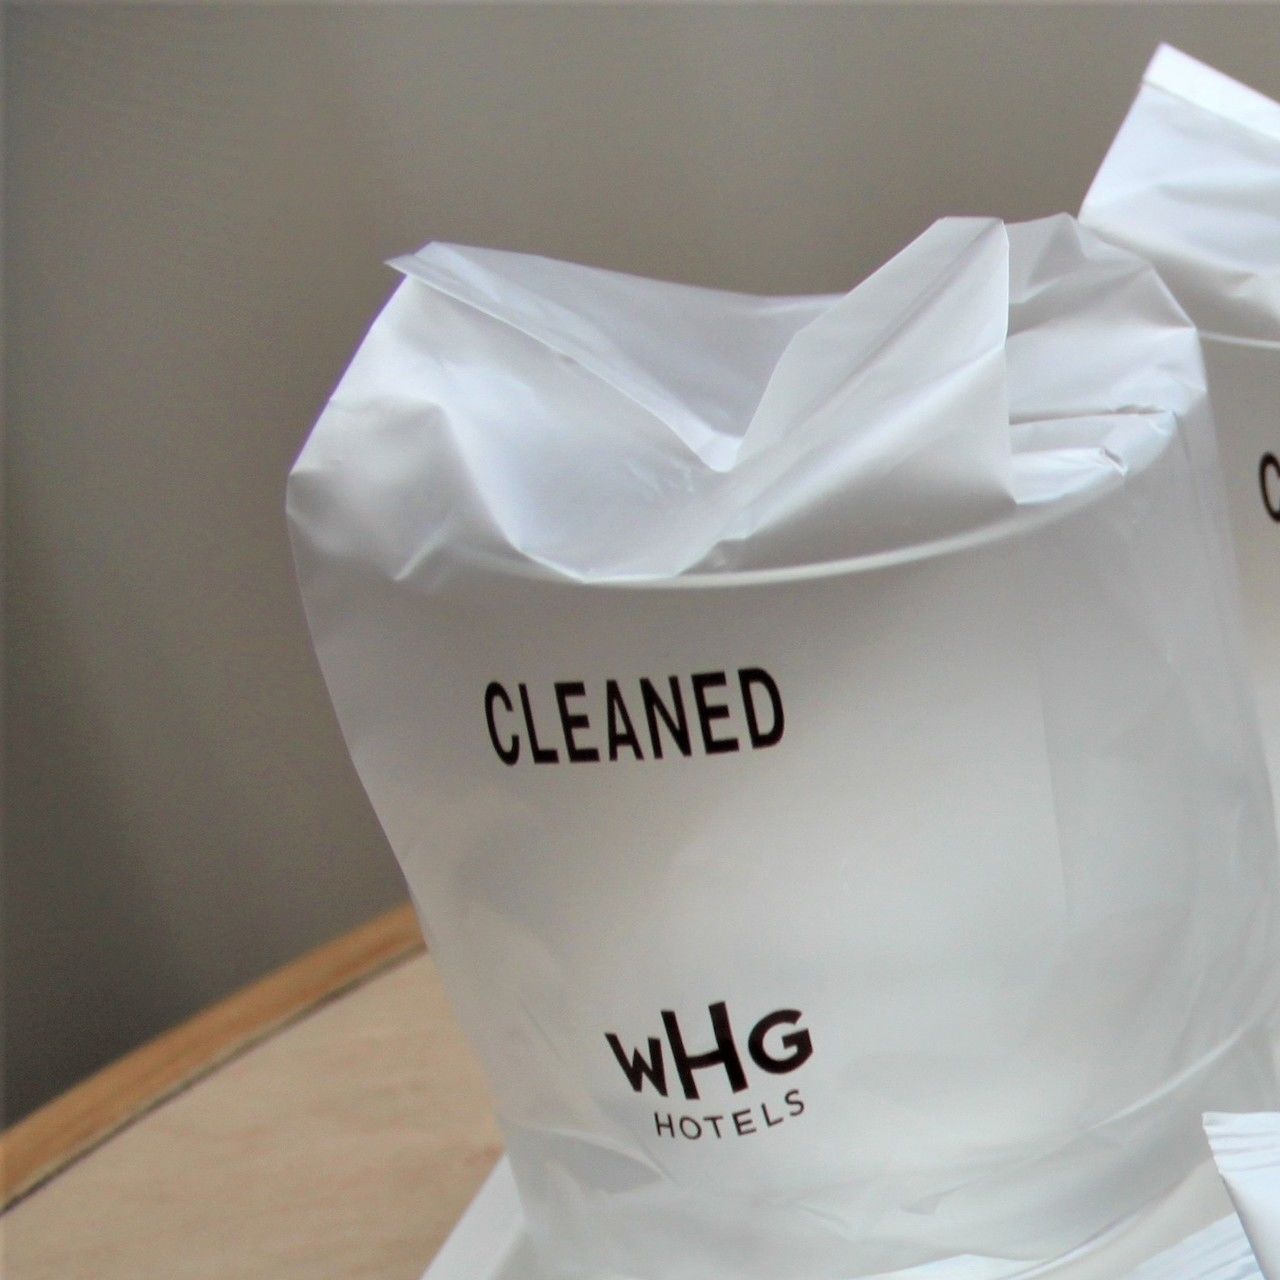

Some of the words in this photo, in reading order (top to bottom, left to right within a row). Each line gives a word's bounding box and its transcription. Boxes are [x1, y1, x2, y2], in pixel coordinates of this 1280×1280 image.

[484, 666, 786, 767] CLEANED
[604, 1001, 814, 1101] WHG
[654, 1088, 805, 1141] HOTELS
